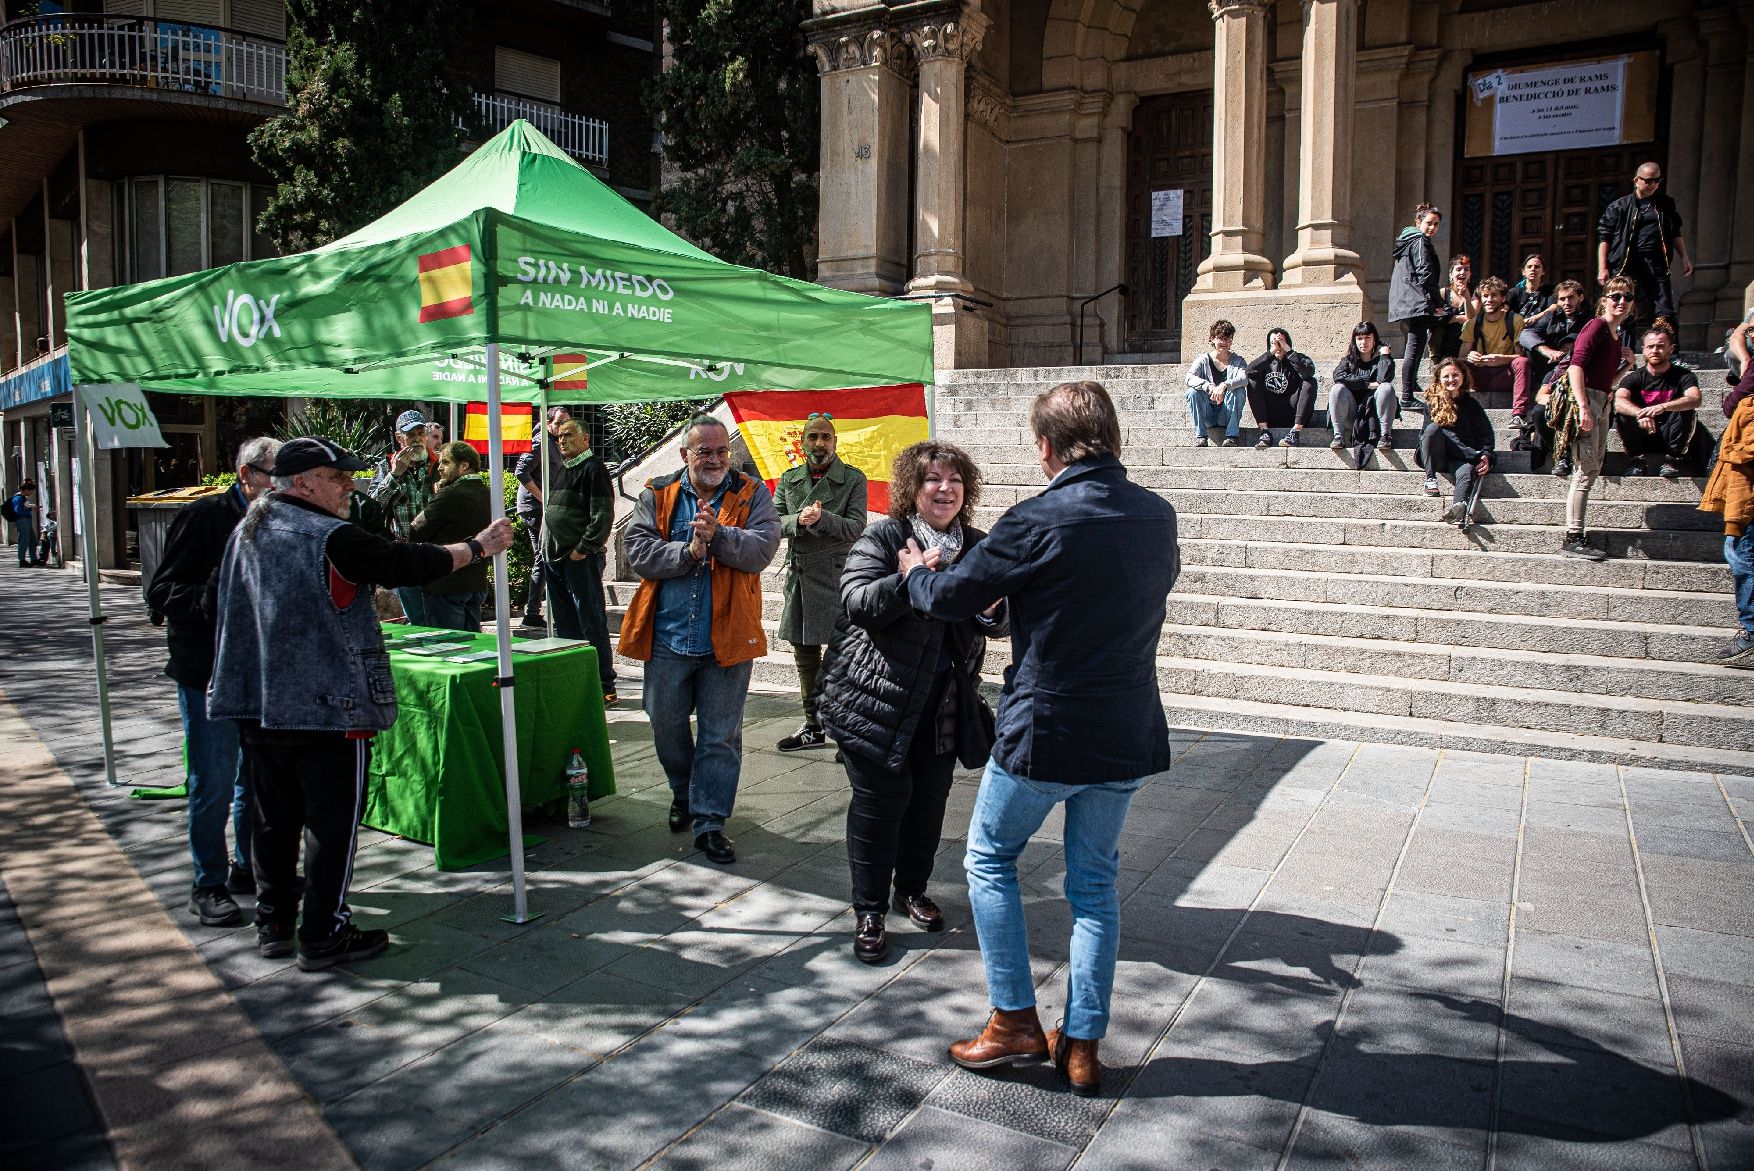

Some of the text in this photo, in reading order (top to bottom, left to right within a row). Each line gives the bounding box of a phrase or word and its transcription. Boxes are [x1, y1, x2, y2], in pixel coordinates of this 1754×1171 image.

[1495, 75, 1503, 86] 2
[1498, 89, 1565, 104] BENEDICCIÓ
[1567, 87, 1582, 97] DE
[1507, 72, 1609, 91] DIUMENGE DE RAMS
[516, 256, 674, 300] SIN MIEDO
[213, 289, 281, 347] VOX
[520, 290, 673, 323] A NADA NI A NADIE
[98, 397, 153, 430] VOX
